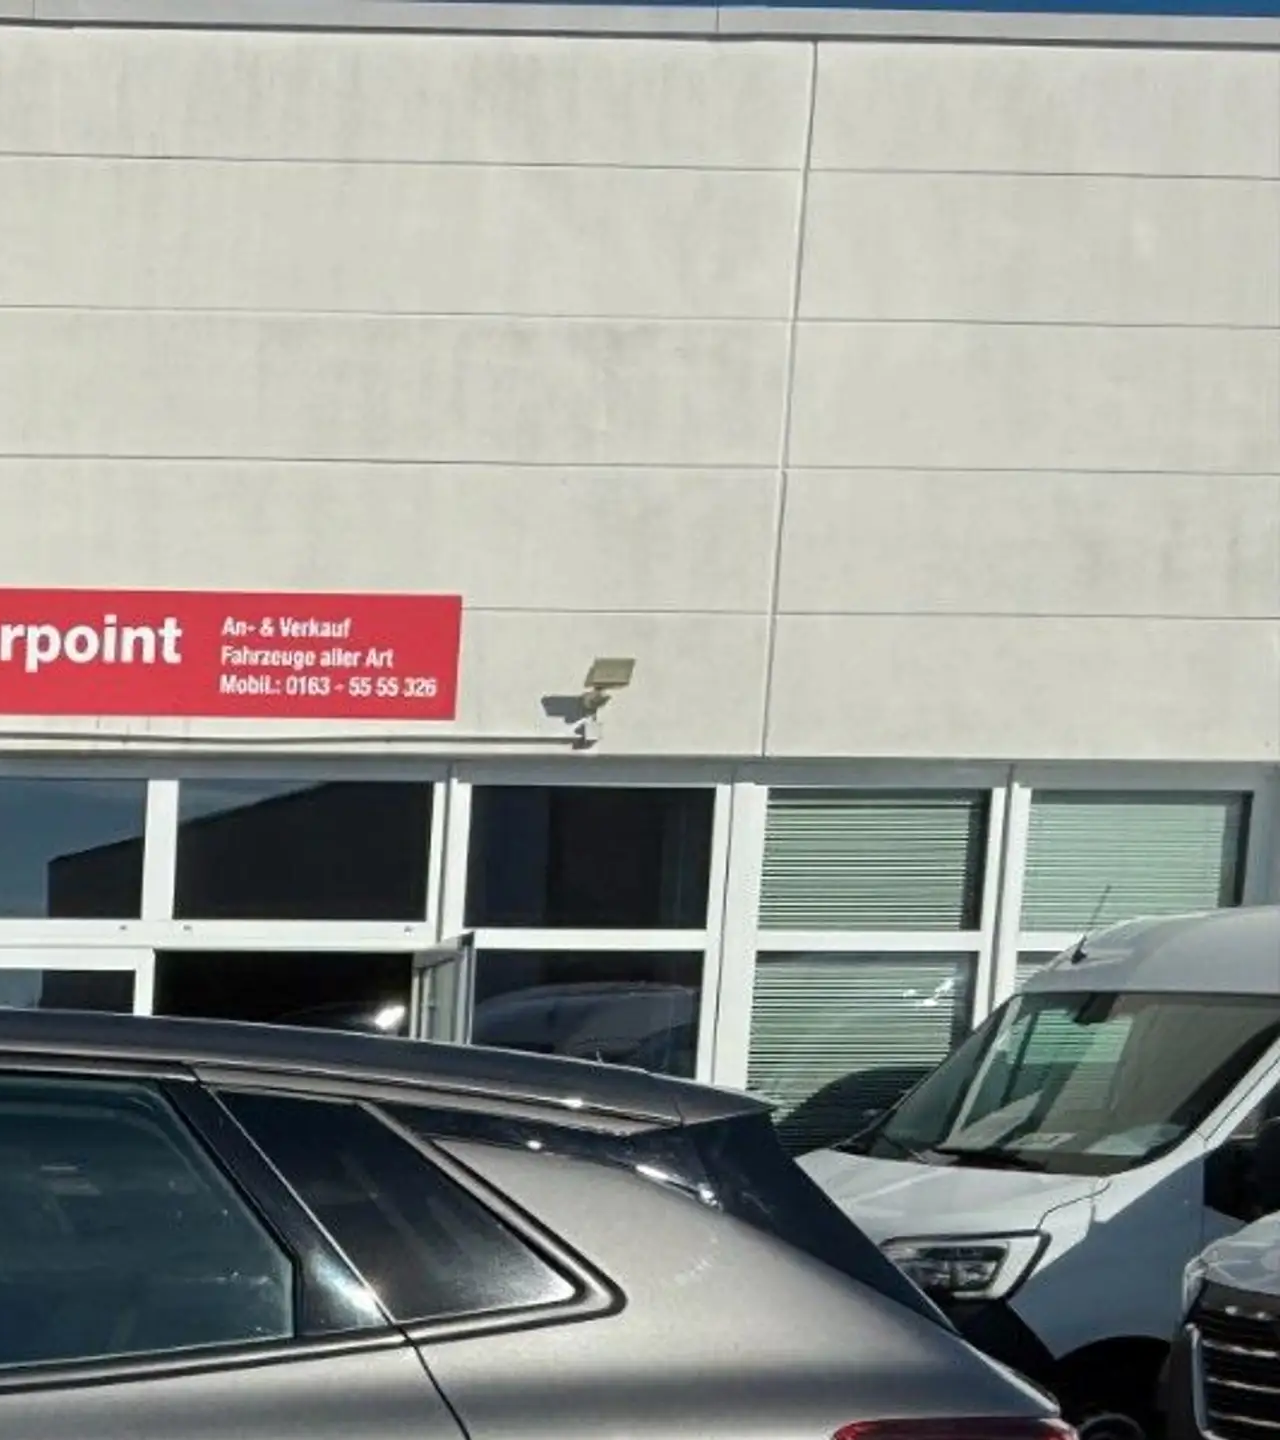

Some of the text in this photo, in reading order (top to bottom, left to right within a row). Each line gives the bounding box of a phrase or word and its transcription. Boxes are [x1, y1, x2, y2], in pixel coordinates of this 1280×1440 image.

[221, 616, 352, 638] An- & Verkauf
[221, 645, 394, 670] Fahrzeuge aller Art
[286, 675, 330, 695] 0163
[349, 677, 372, 696] 55
[376, 677, 399, 697] 55
[403, 678, 437, 698] 326
